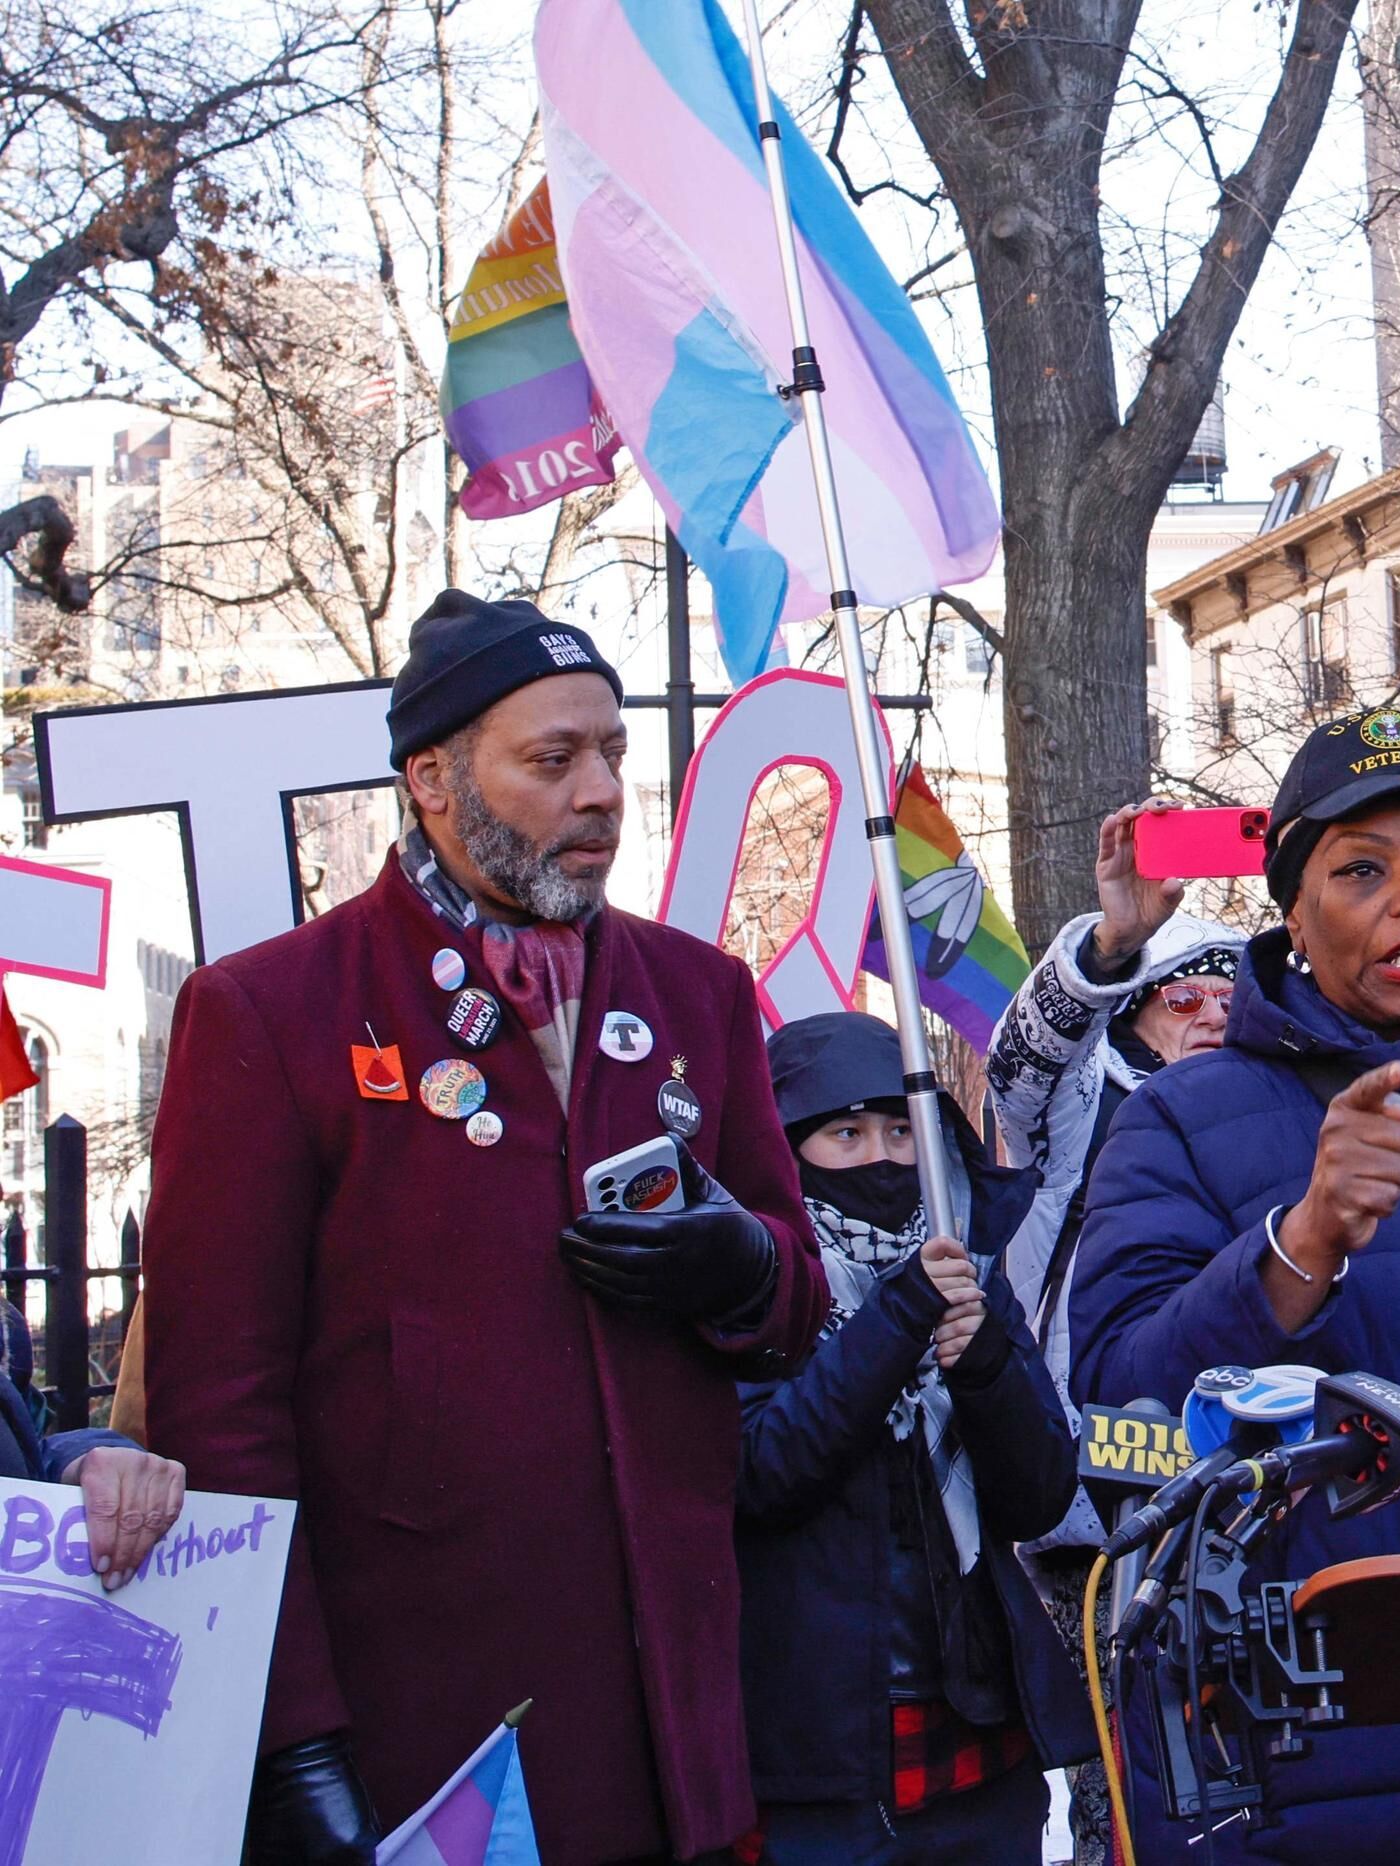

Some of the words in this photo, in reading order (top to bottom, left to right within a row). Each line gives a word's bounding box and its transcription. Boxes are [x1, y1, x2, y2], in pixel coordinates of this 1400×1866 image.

[539, 633, 577, 647] GAYS
[552, 651, 591, 667] GUNS
[32, 678, 400, 967] T
[447, 990, 477, 1032] QUEER
[465, 1003, 495, 1046] MARCH
[608, 1022, 640, 1052] T
[436, 1069, 466, 1106] TRUTH
[663, 1092, 700, 1121] WTAF
[625, 1176, 676, 1207] FASCISM
[633, 1173, 664, 1191] FUCK
[1198, 1368, 1250, 1387] abc
[136, 1503, 275, 1582] ithout
